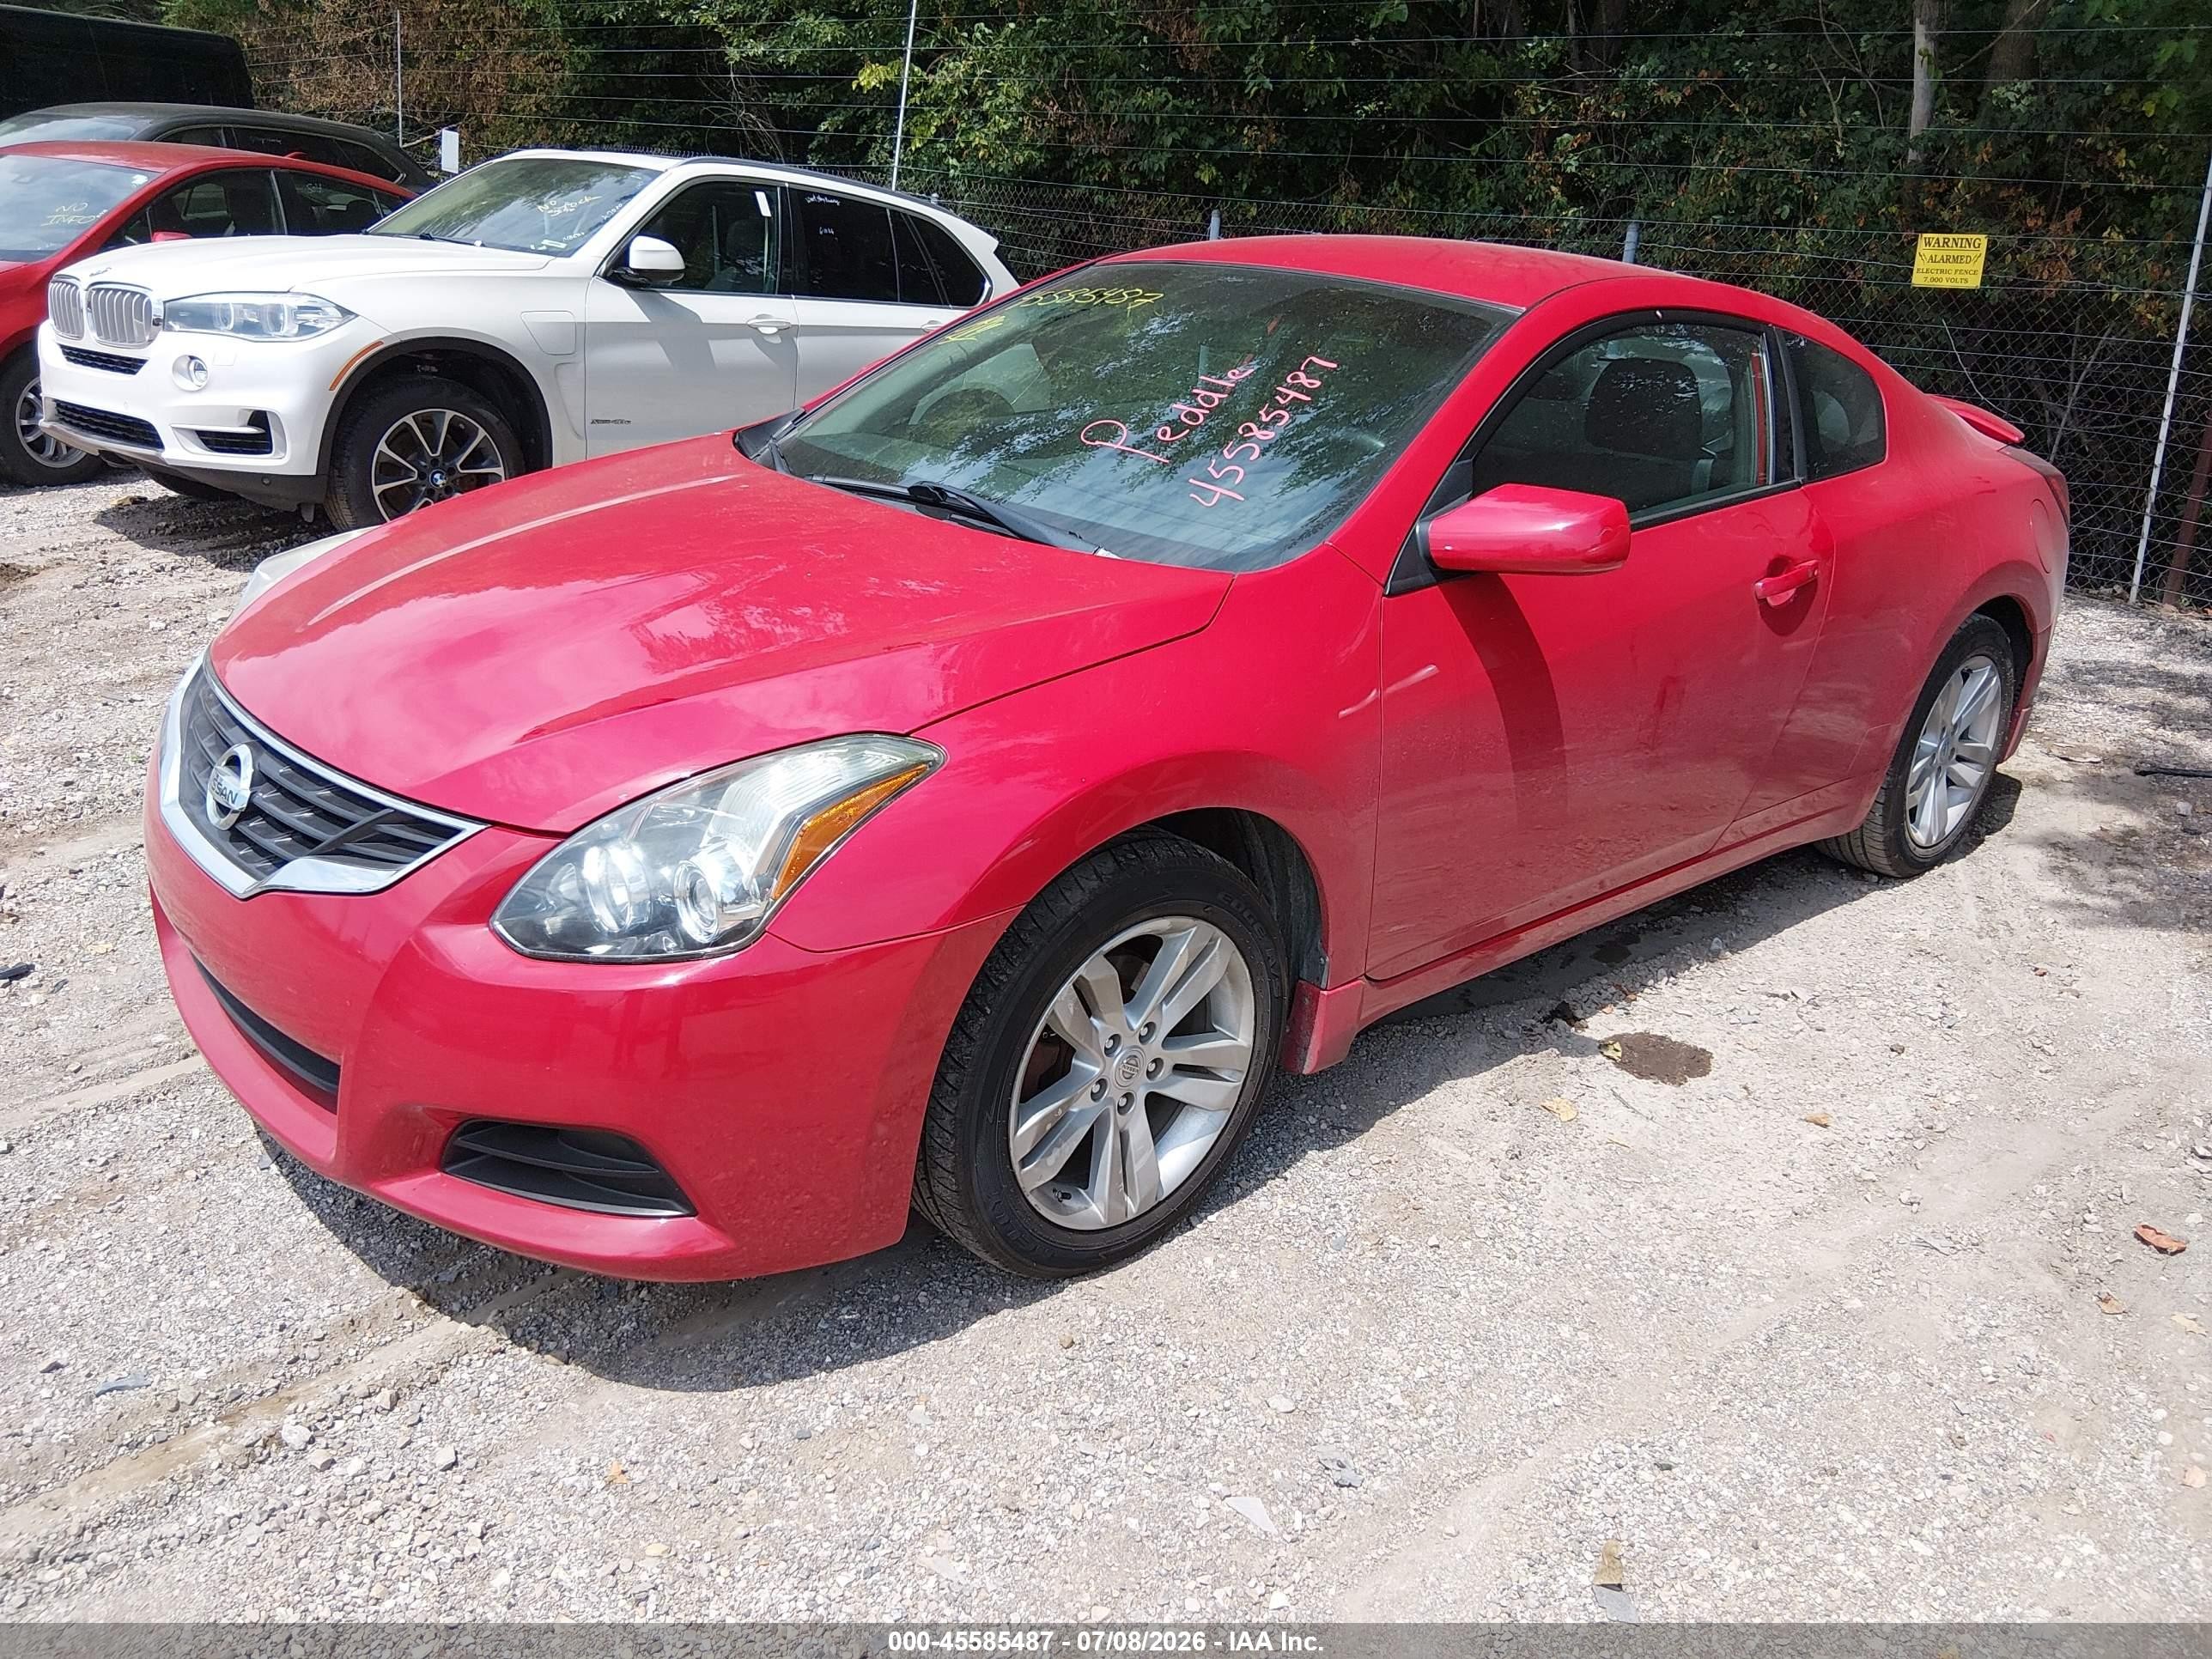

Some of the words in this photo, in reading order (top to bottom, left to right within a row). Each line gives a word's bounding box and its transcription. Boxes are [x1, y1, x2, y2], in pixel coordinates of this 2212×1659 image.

[56, 202, 88, 212] NO
[1923, 236, 1982, 249] WARNING
[1927, 253, 1972, 264] ALARMED
[1916, 267, 1953, 276] ELECTRIC
[1080, 368, 1255, 464] Peddle
[1188, 356, 1338, 507] 45585487
